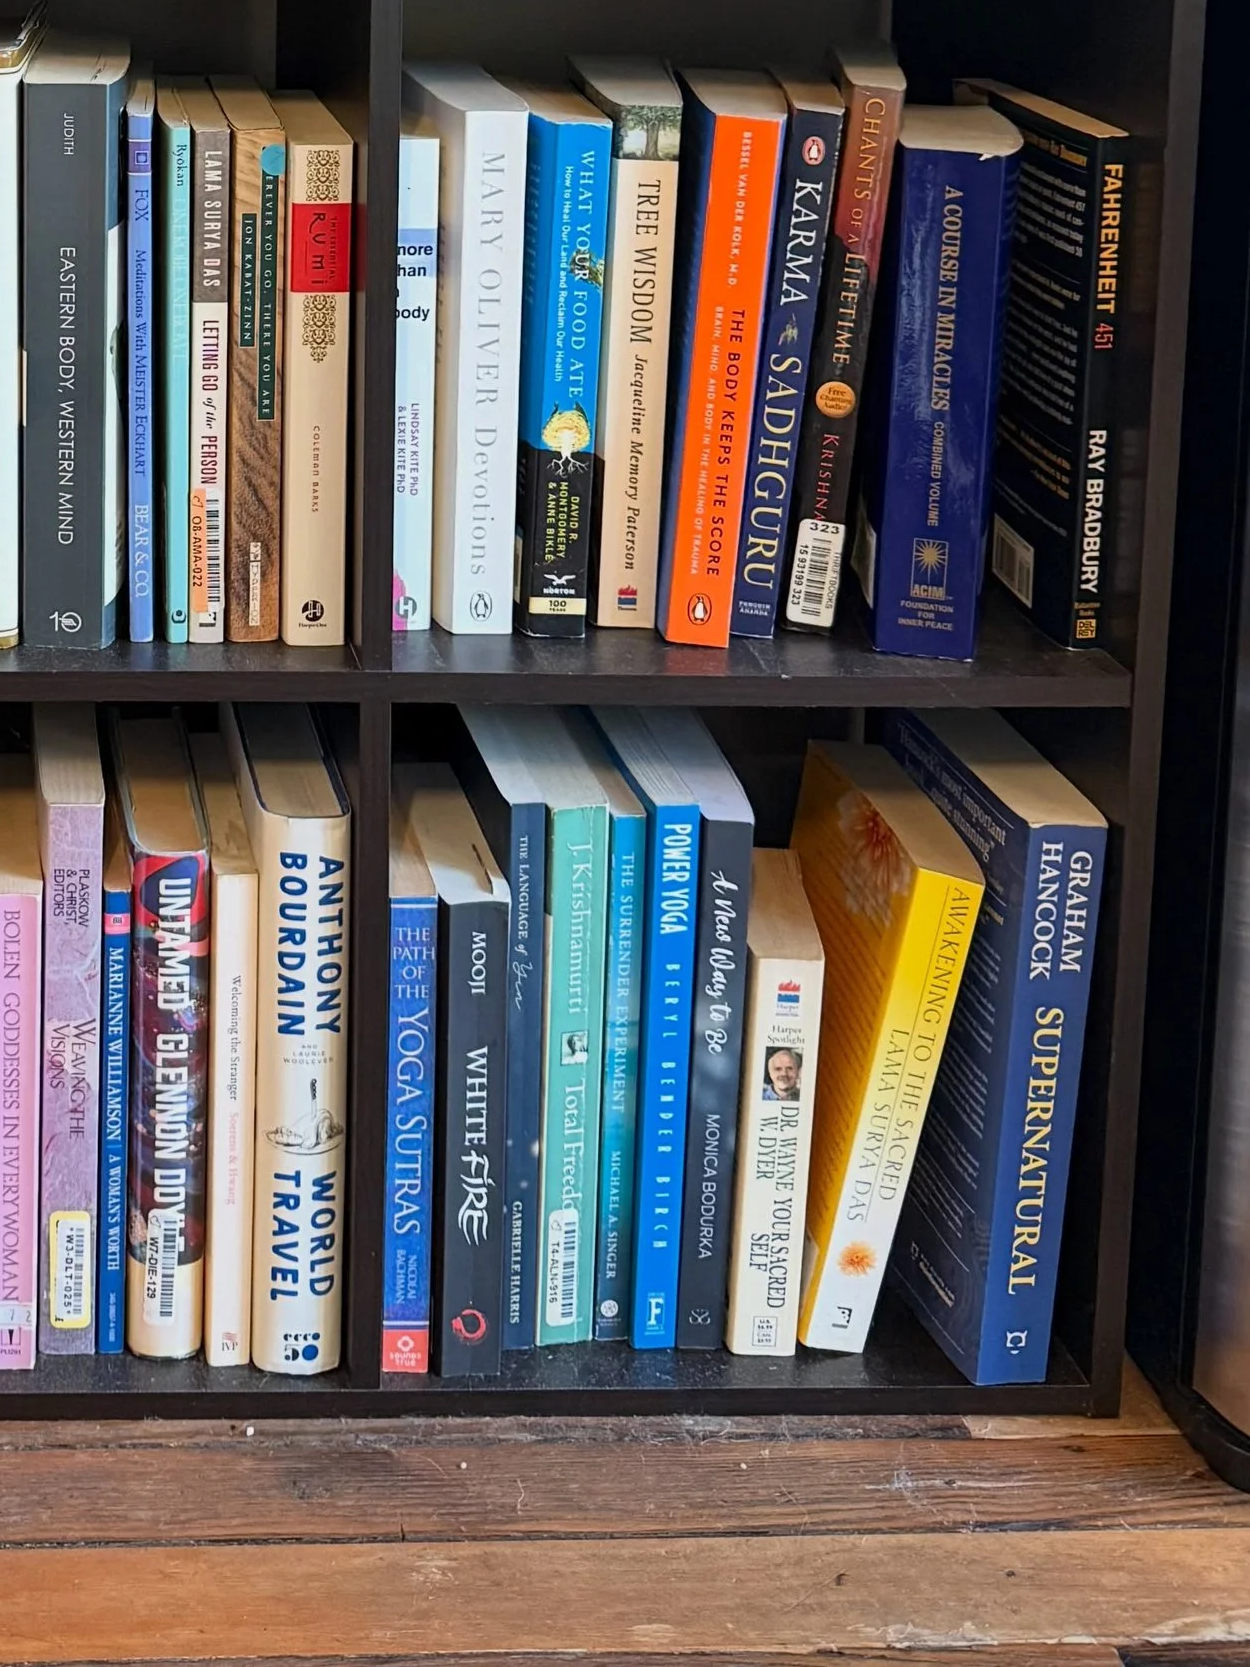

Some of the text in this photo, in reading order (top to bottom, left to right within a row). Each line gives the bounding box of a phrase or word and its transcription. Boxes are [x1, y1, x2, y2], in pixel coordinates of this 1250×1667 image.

[630, 179, 662, 345] TREE WISDOM
[57, 246, 77, 546] EASTERN BODY, WESTERN MIND
[742, 178, 824, 589] KARMA SADHGURU
[1079, 163, 1124, 594] FAHRENHEIT 451 RAY BRADBURY
[278, 851, 308, 1036] BOURDAIN
[318, 854, 345, 1034] ANTHONY
[1029, 841, 1063, 980] HANCOCK
[1060, 850, 1091, 973] GRAHAM
[156, 877, 192, 1159] UNTAMED GLENNON
[281, 1057, 334, 1066] WOOLEVER
[292, 1050, 328, 1058] LAURIE
[457, 931, 488, 1245] MOOJI WHITE FIRE
[394, 1011, 428, 1234] YOGA SUTRAS
[1008, 1007, 1064, 1296] SUPERNATURAL
[270, 1169, 301, 1303] TRAVEL
[308, 1170, 336, 1298] WORLD
